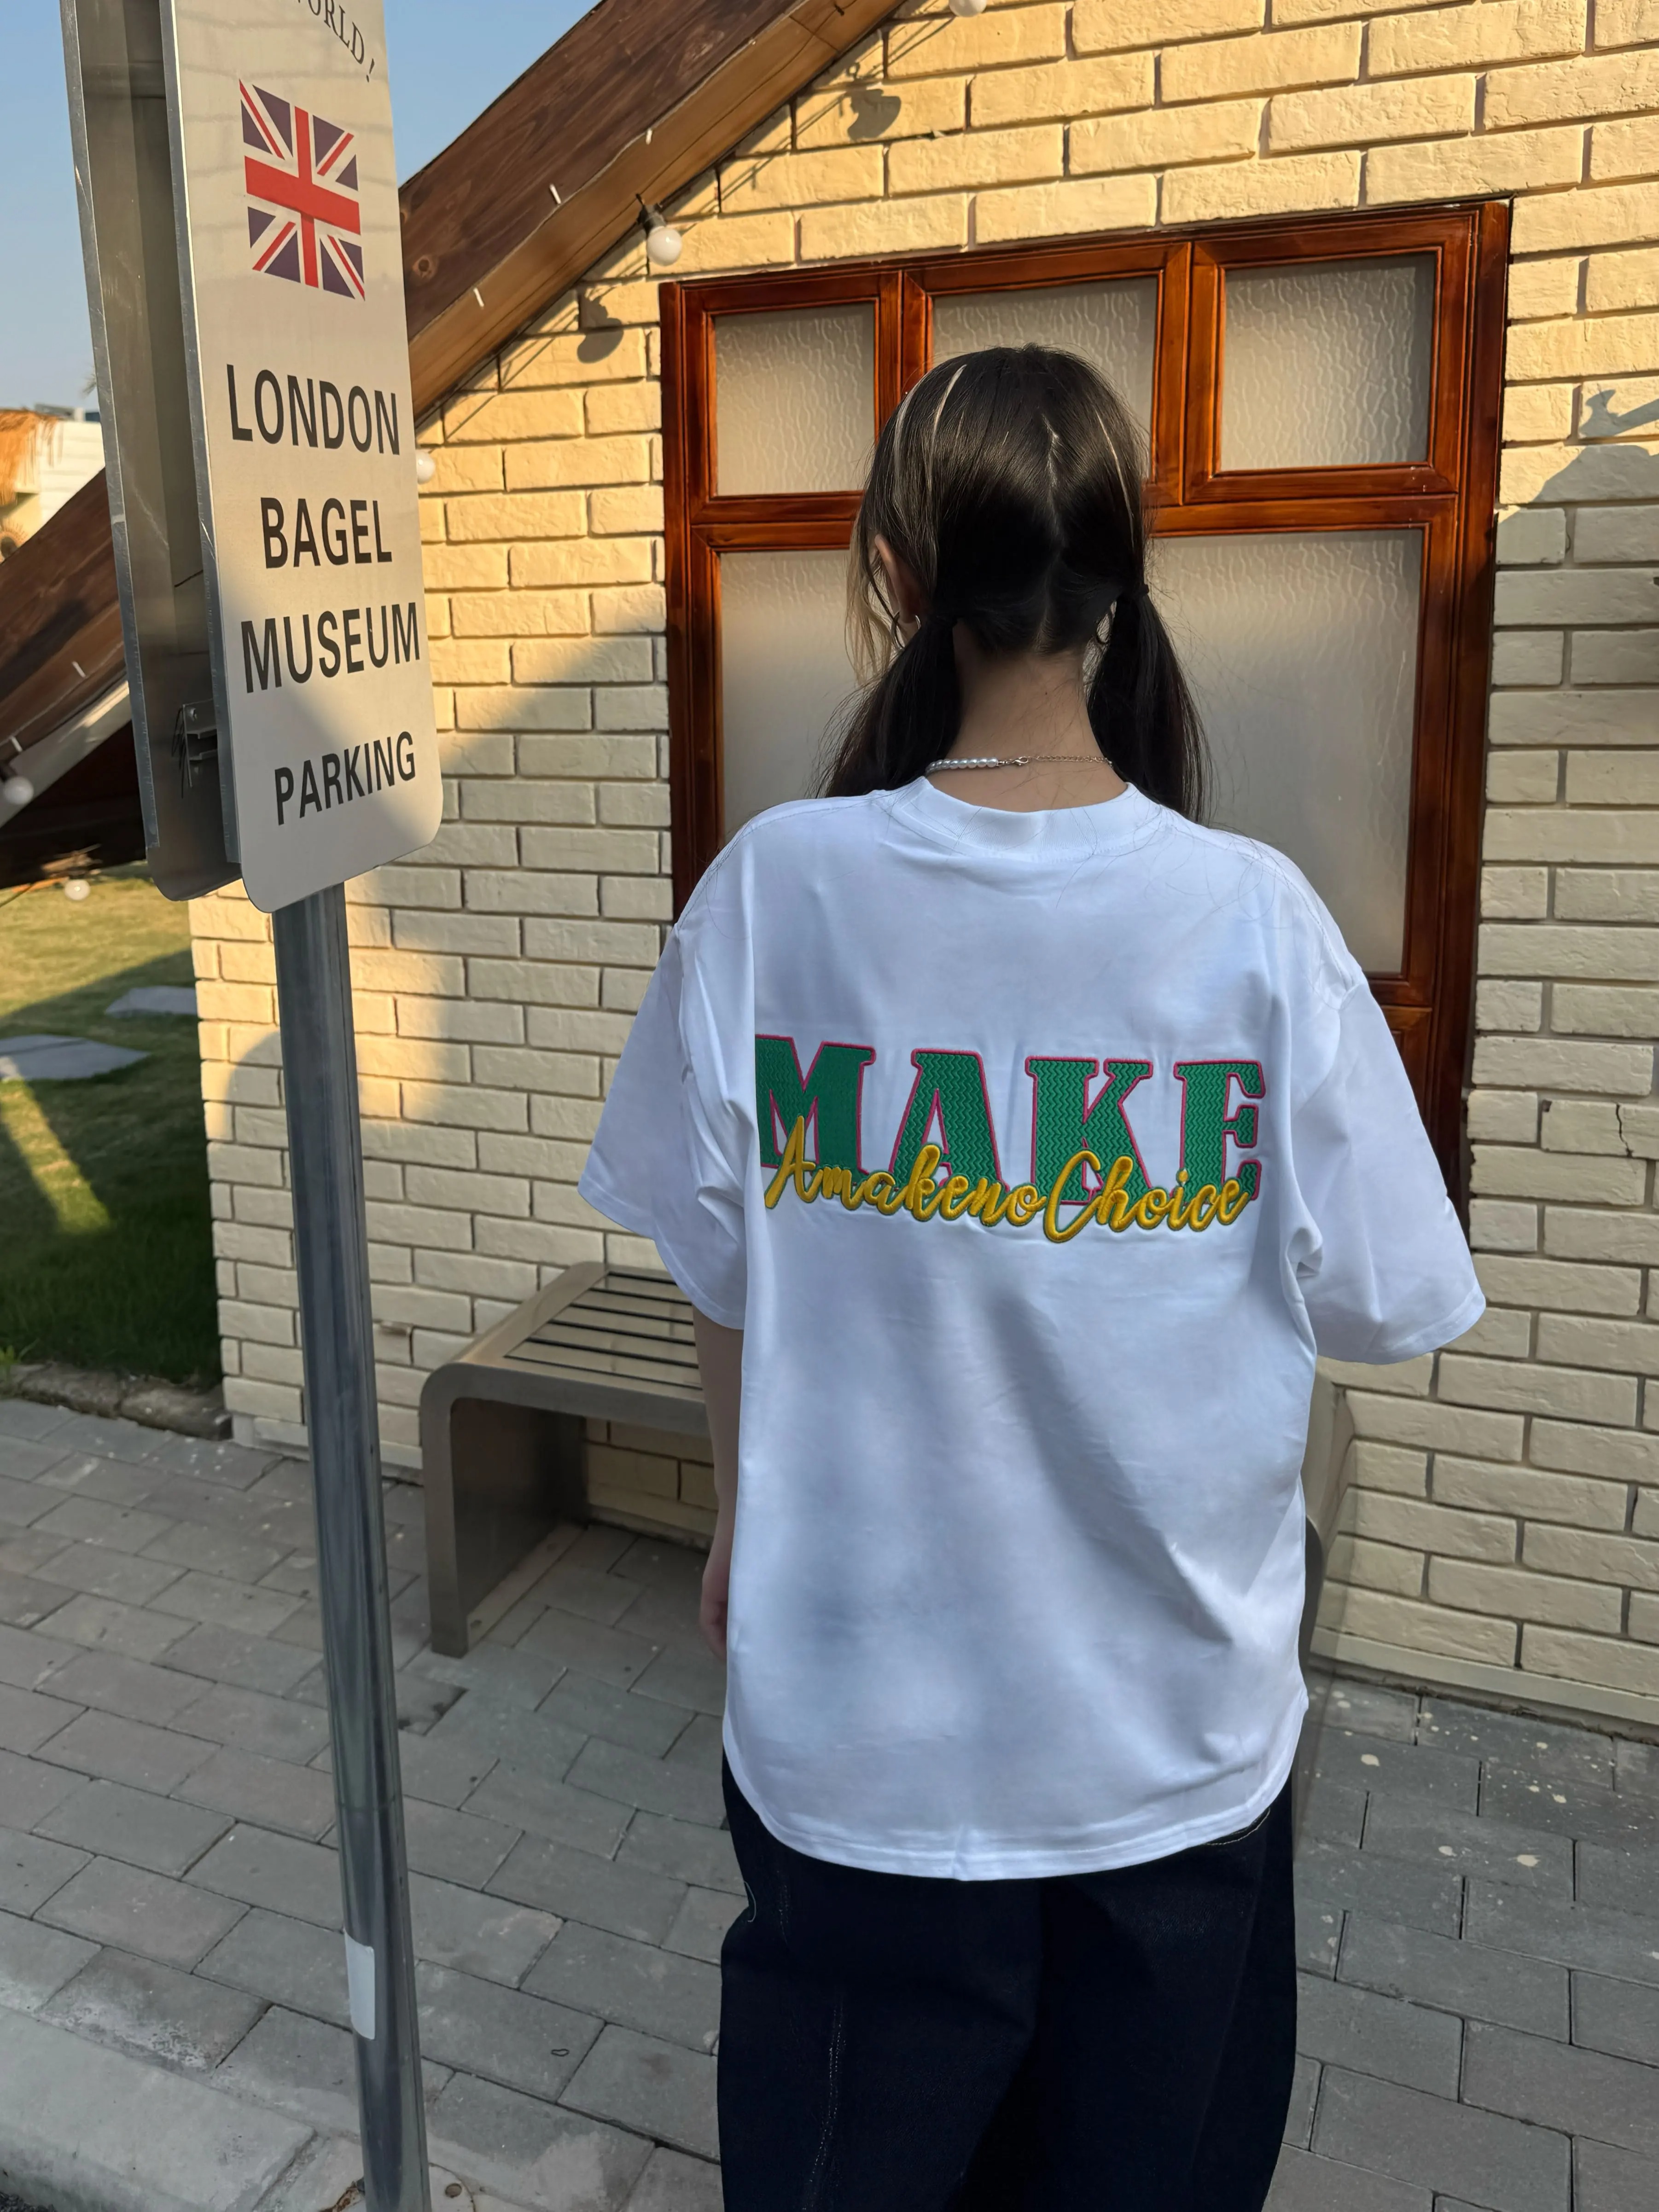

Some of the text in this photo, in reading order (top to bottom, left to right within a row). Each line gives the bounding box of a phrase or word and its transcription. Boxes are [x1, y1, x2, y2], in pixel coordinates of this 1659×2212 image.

[227, 364, 400, 455] LONDON
[261, 497, 392, 569] BAGEL
[241, 602, 419, 693] MUSEUM
[274, 732, 415, 825] PARKING
[755, 1034, 1265, 1206] MAKE
